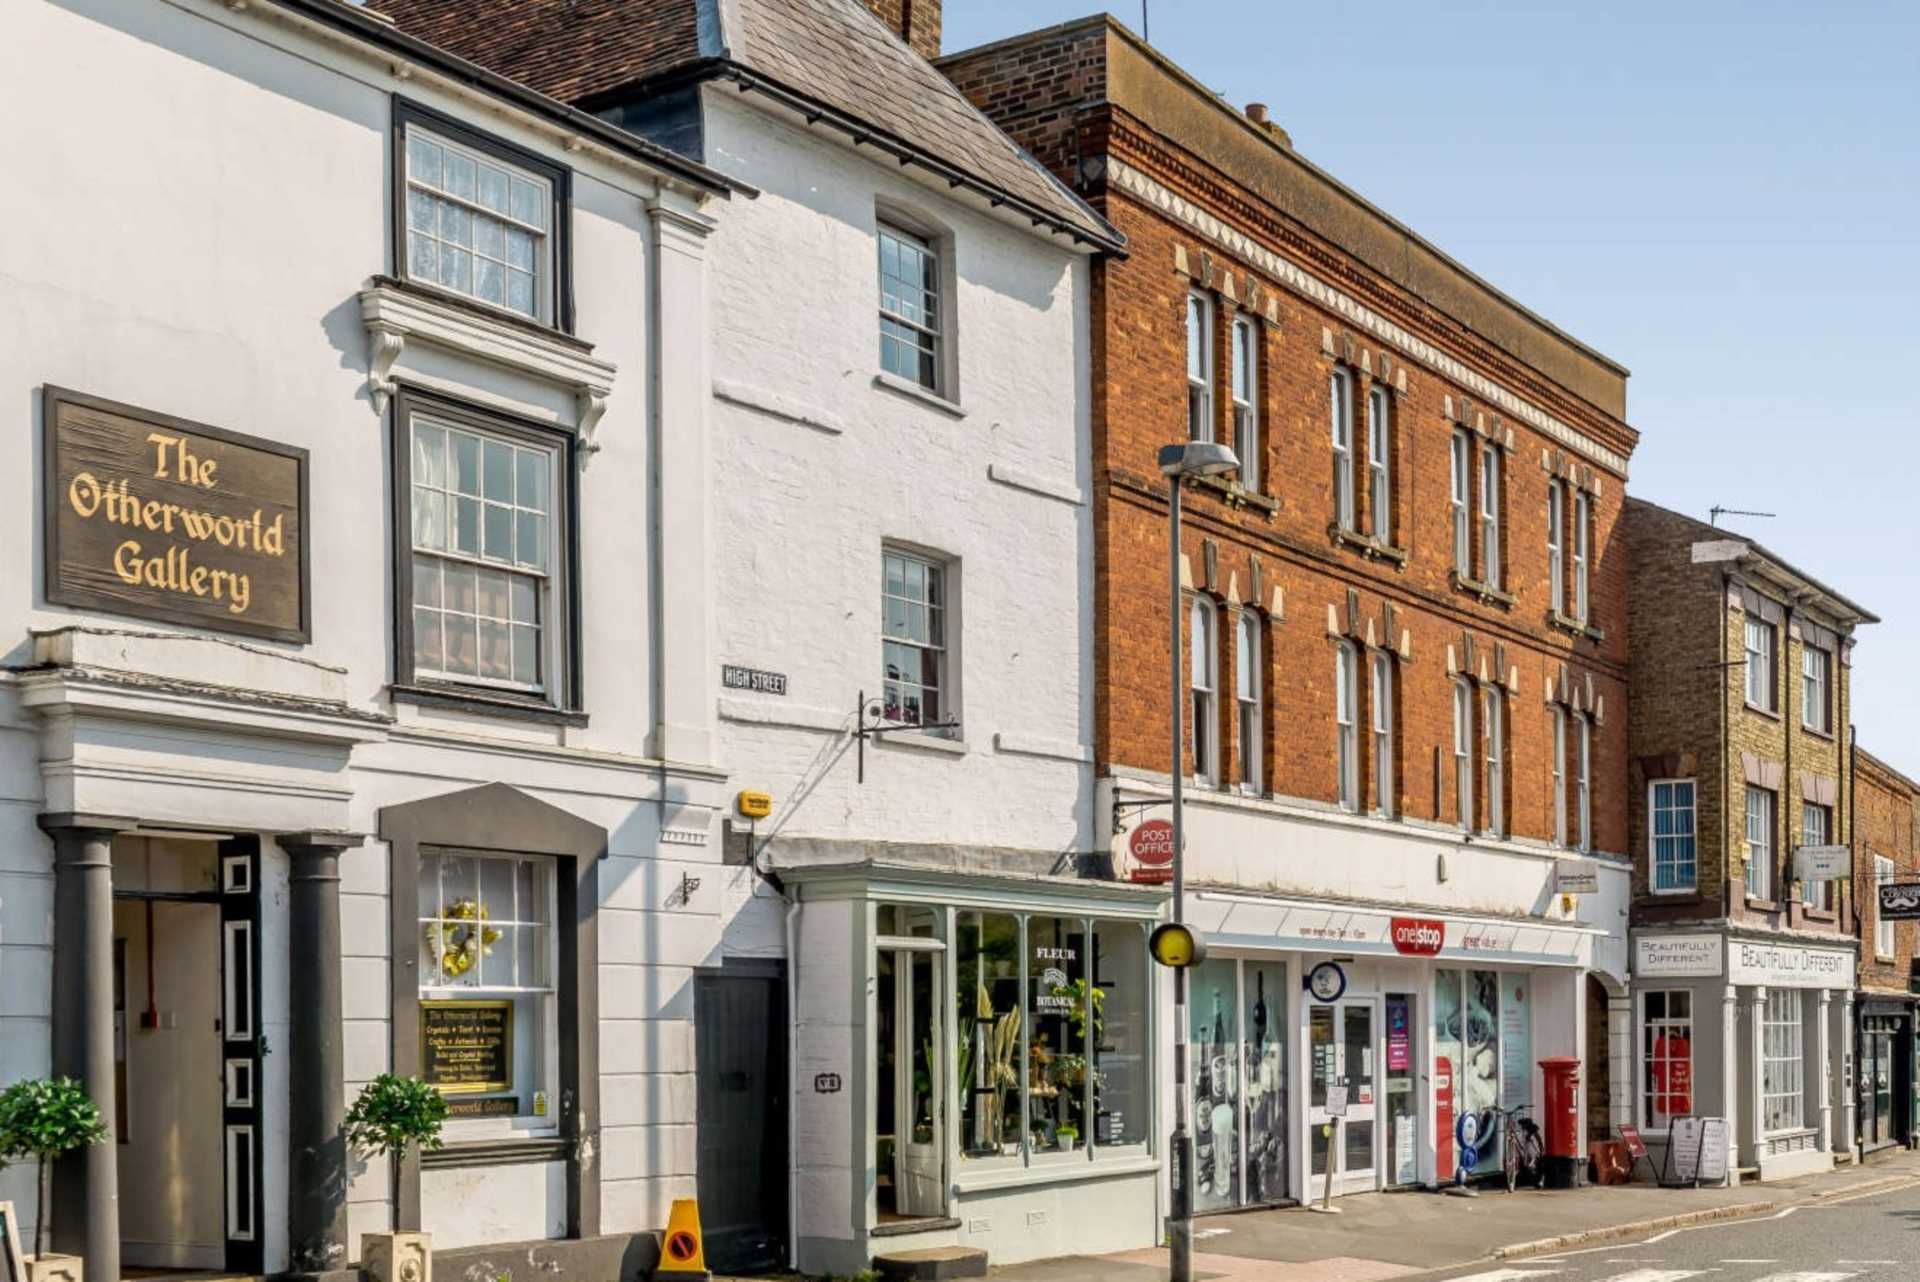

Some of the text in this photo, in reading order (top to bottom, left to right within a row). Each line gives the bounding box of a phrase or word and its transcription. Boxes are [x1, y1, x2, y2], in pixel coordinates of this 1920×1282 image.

[147, 432, 217, 489] The
[69, 472, 285, 557] Otherworld
[114, 540, 251, 614] Gallery
[725, 667, 785, 693] HIGH STREET
[1142, 829, 1173, 841] POST
[1036, 947, 1076, 961] FLEUR
[1641, 941, 1717, 953] BEAUTIFULLY
[1648, 953, 1710, 965] DIFFERENT
[1741, 945, 1844, 974] BEAUTIFULLY DIFFERENT
